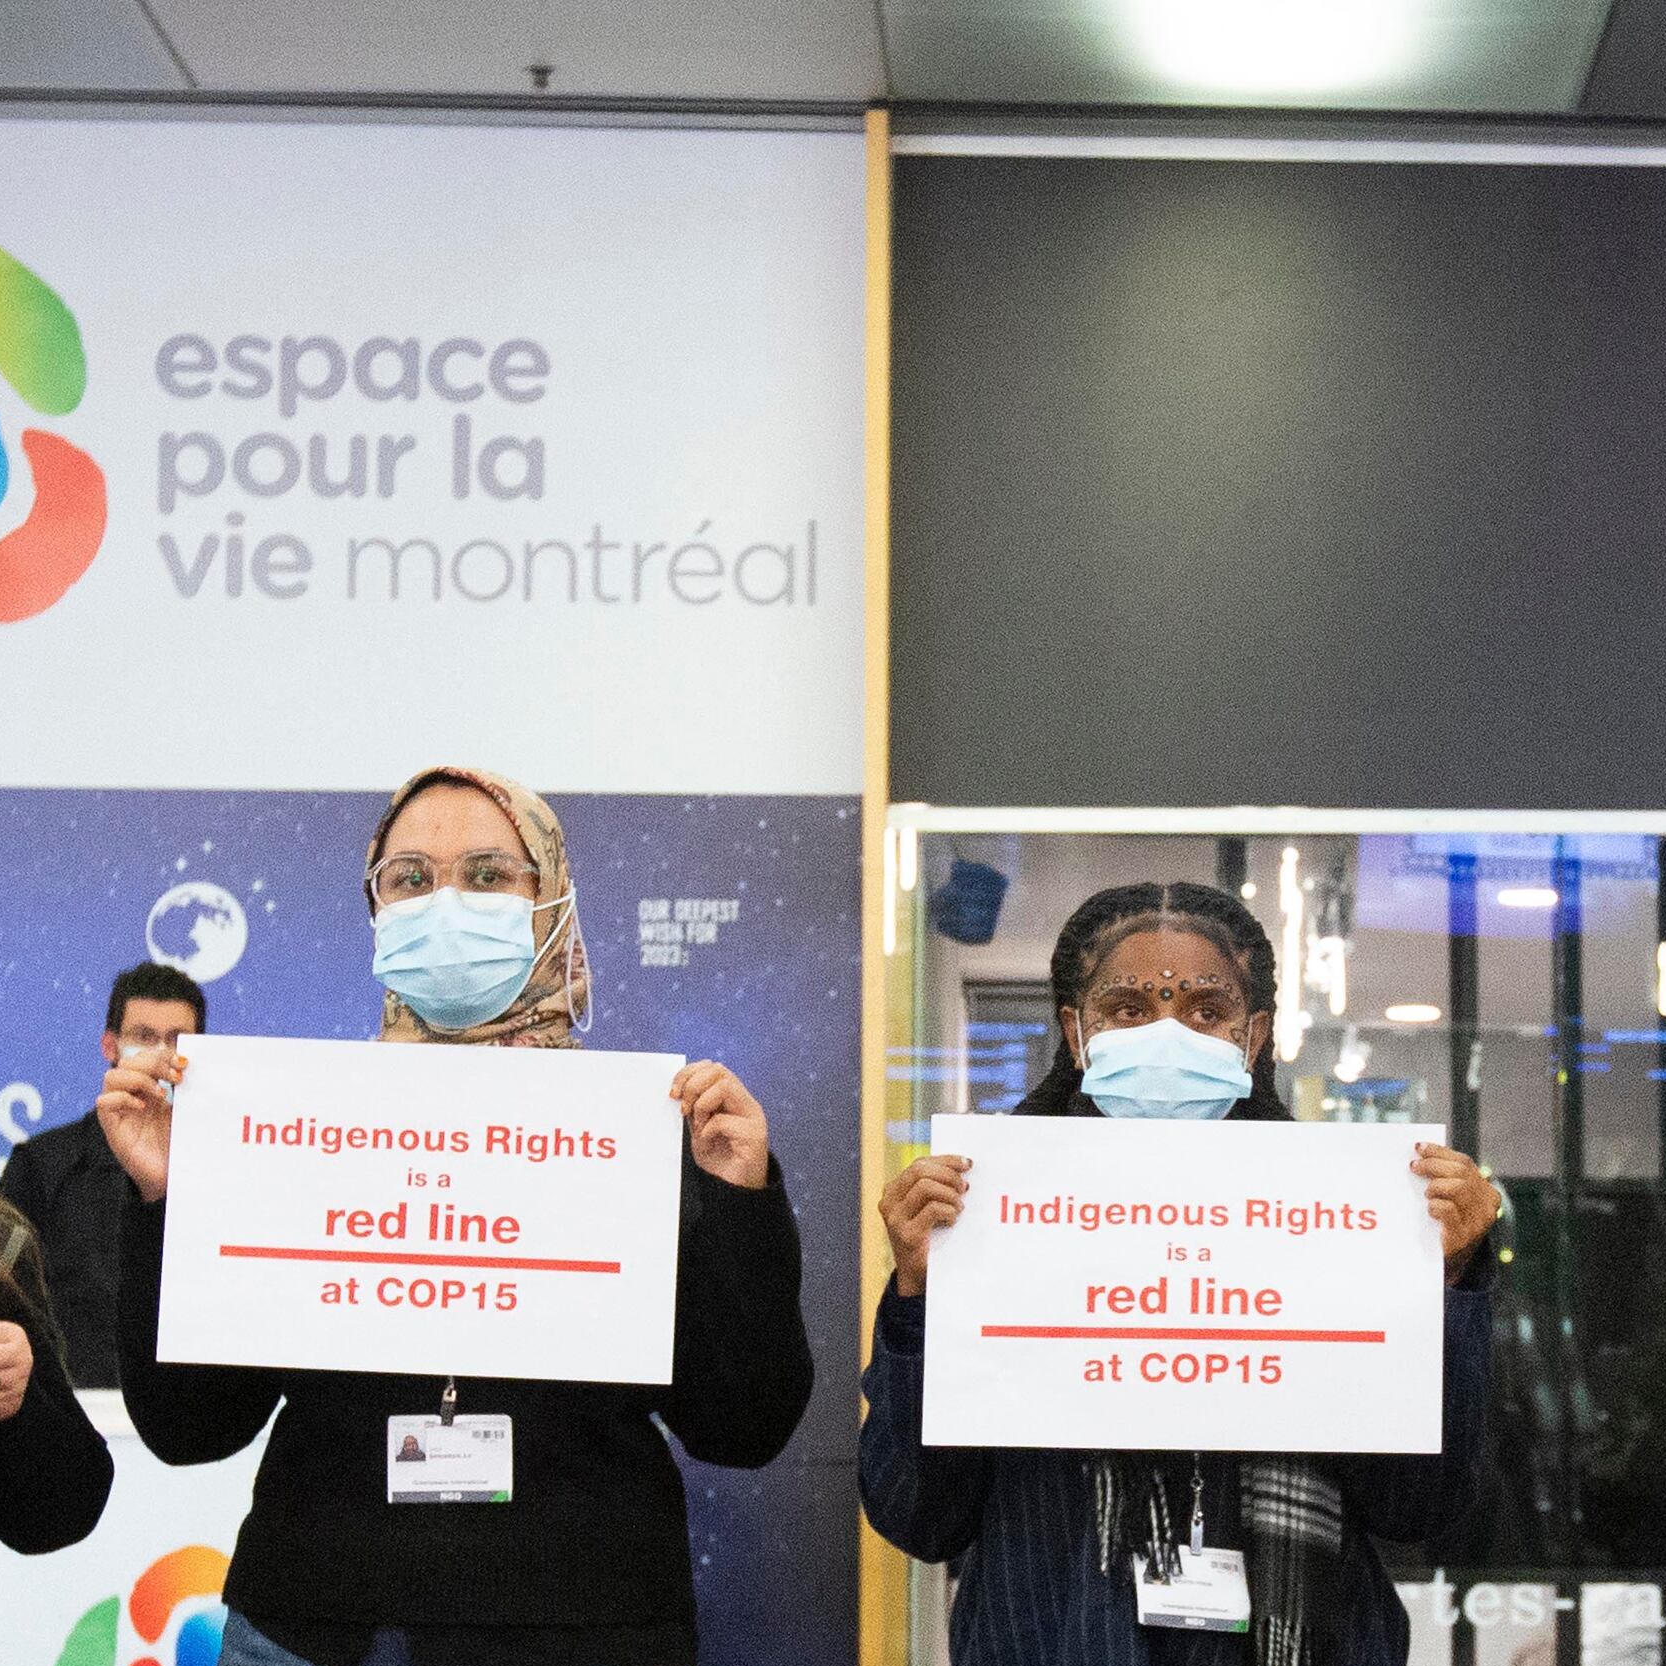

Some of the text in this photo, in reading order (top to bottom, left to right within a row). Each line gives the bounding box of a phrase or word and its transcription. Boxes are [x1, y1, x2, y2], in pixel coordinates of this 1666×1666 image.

[153, 332, 552, 420] espace
[157, 412, 547, 514] pour la
[156, 511, 818, 608] vie montréal
[241, 1114, 617, 1164] Indigenous Rights
[406, 1168, 452, 1188] is a
[325, 1201, 521, 1245] red line
[999, 1194, 1378, 1236] Indigenous Rights
[1167, 1243, 1212, 1261] is a
[319, 1276, 518, 1312] at COP15
[1086, 1276, 1283, 1317] red line
[1083, 1351, 1283, 1386] at COP15
